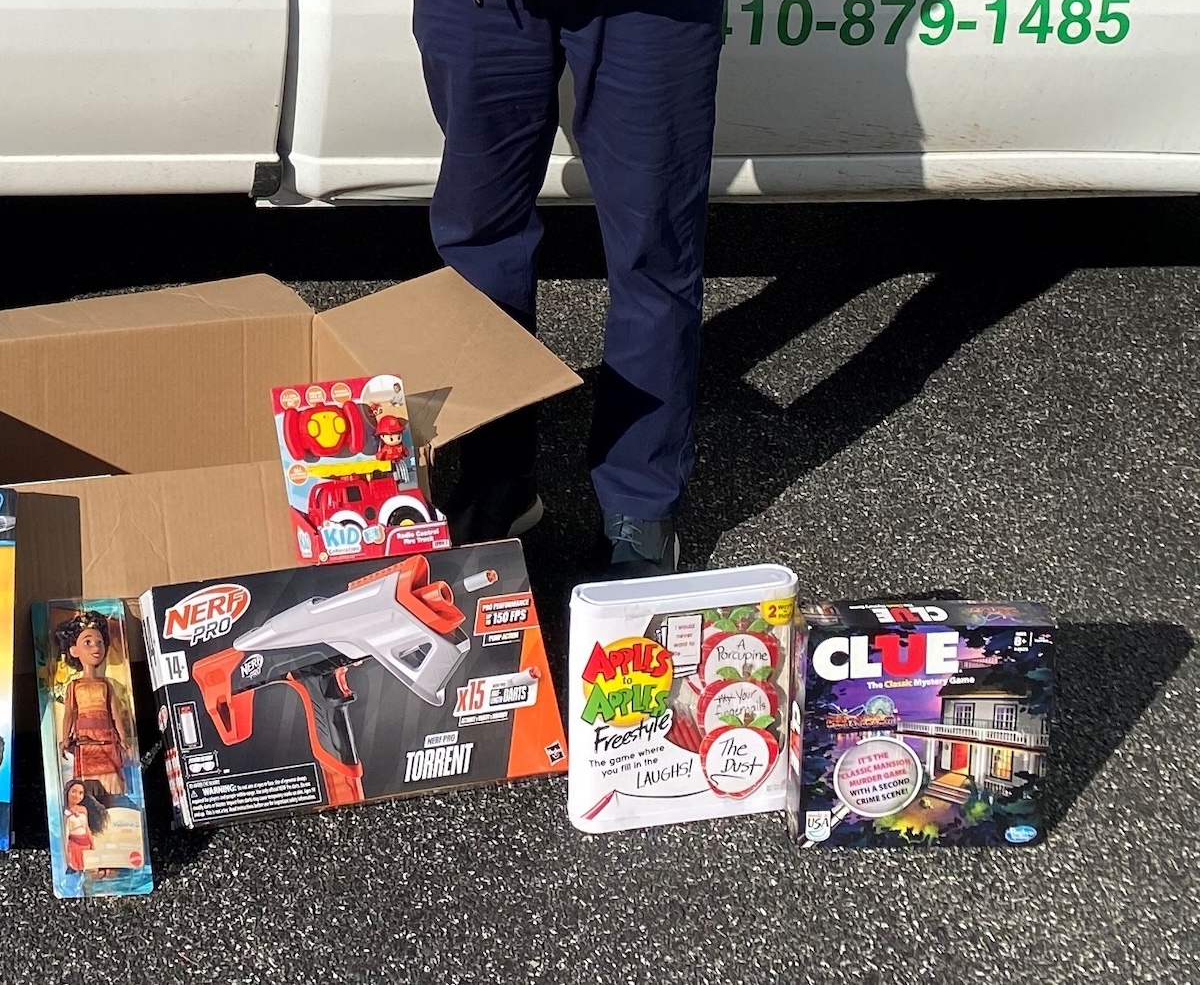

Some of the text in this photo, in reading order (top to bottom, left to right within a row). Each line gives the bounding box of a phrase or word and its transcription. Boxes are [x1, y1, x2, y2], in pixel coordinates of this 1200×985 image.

[322, 527, 361, 548] KID
[415, 527, 440, 538] Control
[165, 589, 245, 636] NERF
[492, 611, 510, 625] 150
[509, 609, 527, 623] FPS
[768, 604, 776, 618] 2
[191, 616, 232, 645] PRO
[737, 639, 746, 650] A
[716, 646, 769, 664] Porcupine
[813, 632, 960, 681] CLUE
[241, 655, 263, 678] NERF
[622, 677, 633, 685] to
[867, 676, 975, 689] The Classic Mystery Game
[503, 685, 527, 703] DARTS
[427, 734, 456, 745] NERF PRO
[594, 713, 671, 754] Freestyle
[718, 737, 748, 757] The
[404, 742, 474, 783] TORRENT
[589, 745, 665, 768] The game where
[720, 756, 764, 775] Dust
[858, 752, 889, 764] IT'S THE
[601, 768, 619, 778] you
[621, 763, 632, 773] fill
[644, 757, 658, 766] the
[636, 758, 693, 789] LAUGHS!
[841, 758, 911, 780] CLASSIC MANSION
[849, 769, 907, 787] MURDER GAME
[201, 783, 238, 796] WARNING:
[850, 787, 871, 797] WITH
[880, 778, 910, 789] SECOND
[856, 788, 909, 805] CRIME SCENE!
[808, 817, 829, 829] USA
